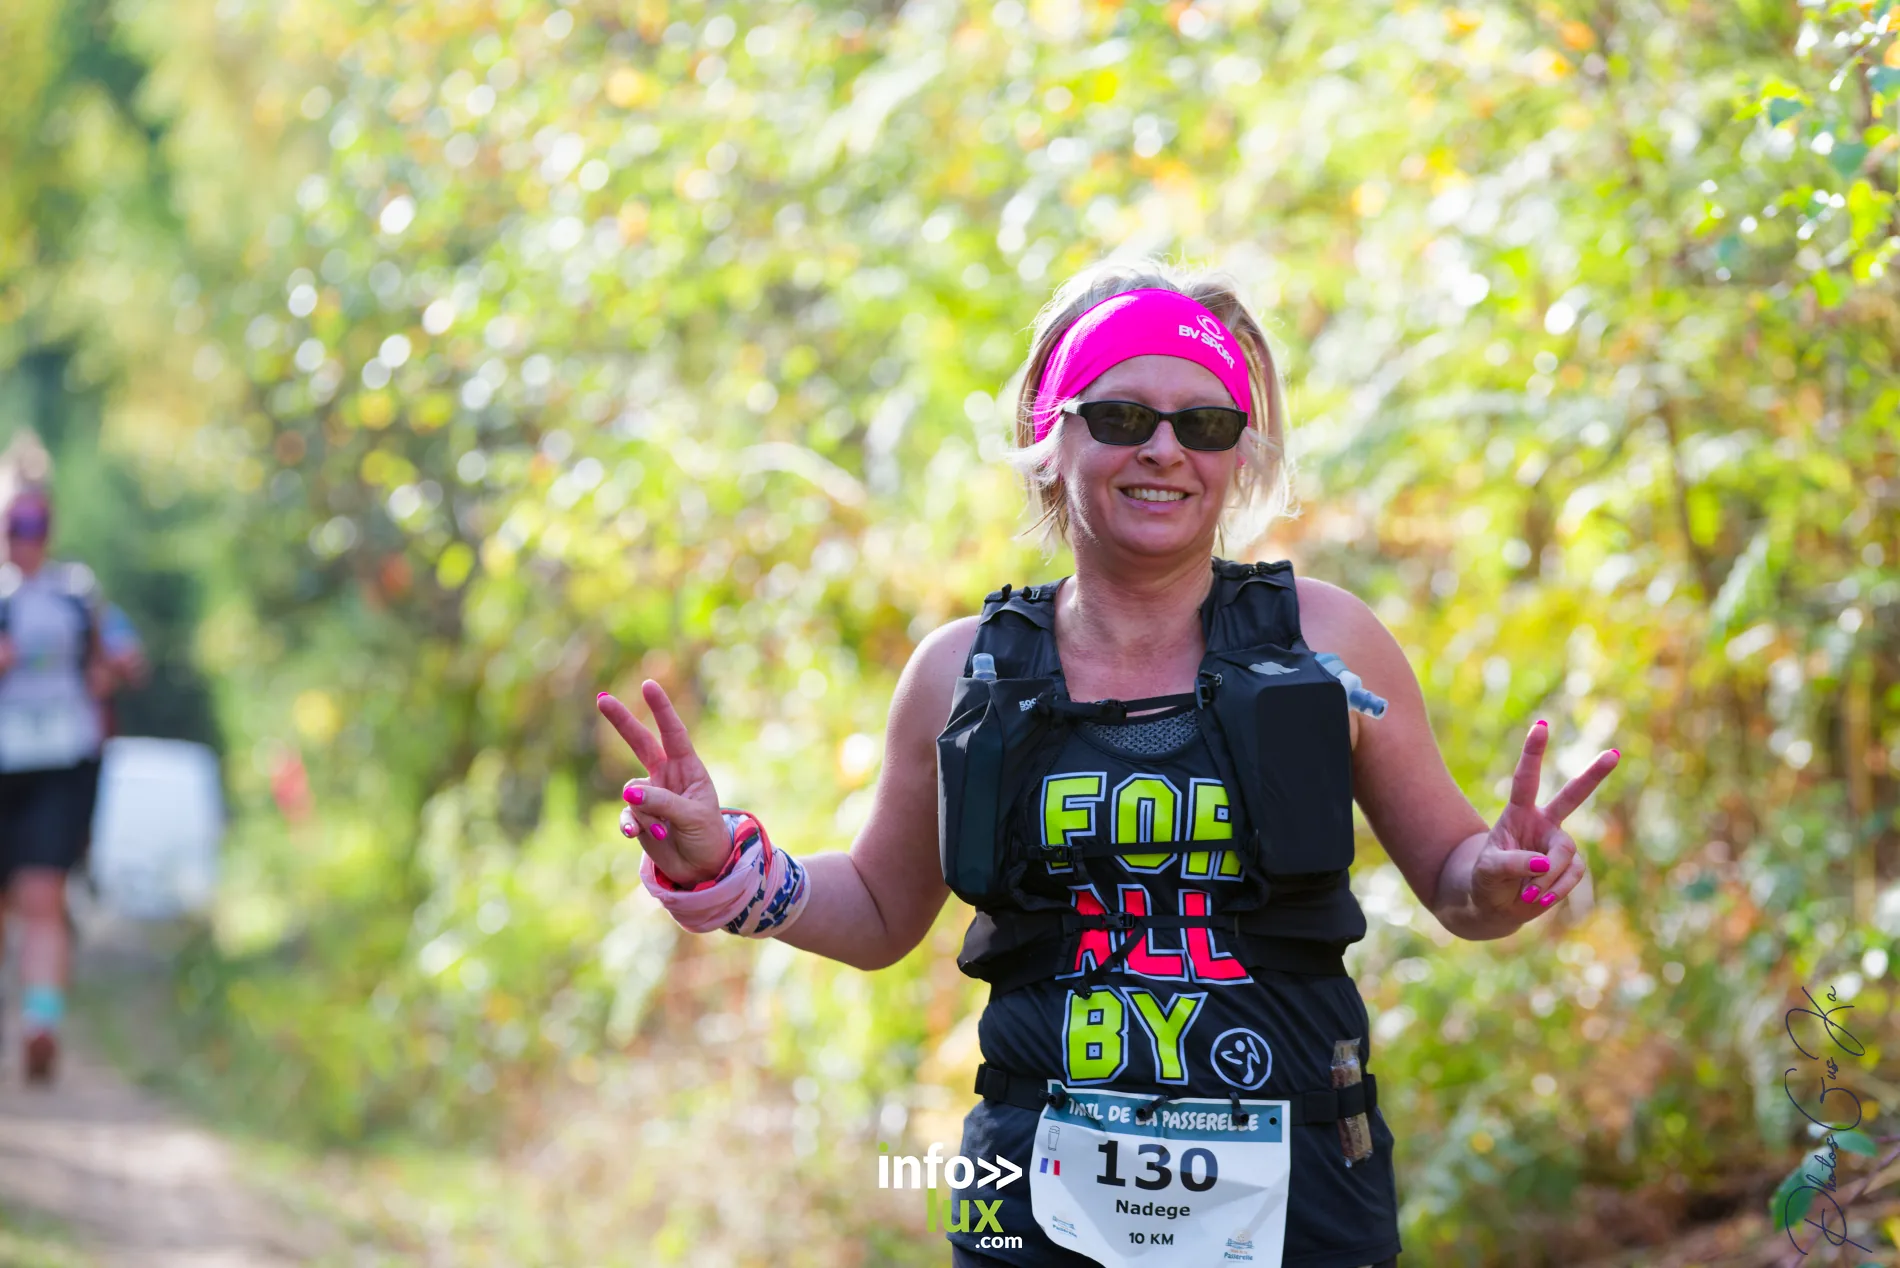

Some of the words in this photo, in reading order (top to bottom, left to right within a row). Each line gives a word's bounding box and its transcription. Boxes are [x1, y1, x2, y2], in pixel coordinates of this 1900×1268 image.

[1178, 324, 1200, 339] BV
[1200, 332, 1235, 370] SPORT
[1040, 771, 1246, 882] FOR
[1055, 884, 1254, 984] ALL
[1062, 985, 1209, 1087] BY
[1108, 1105, 1132, 1124] DE
[1162, 1110, 1259, 1131] PASSERELE
[1096, 1140, 1219, 1192] 130
[1116, 1199, 1191, 1219] Nadege
[1129, 1232, 1145, 1245] 10
[1150, 1233, 1174, 1246] KM
